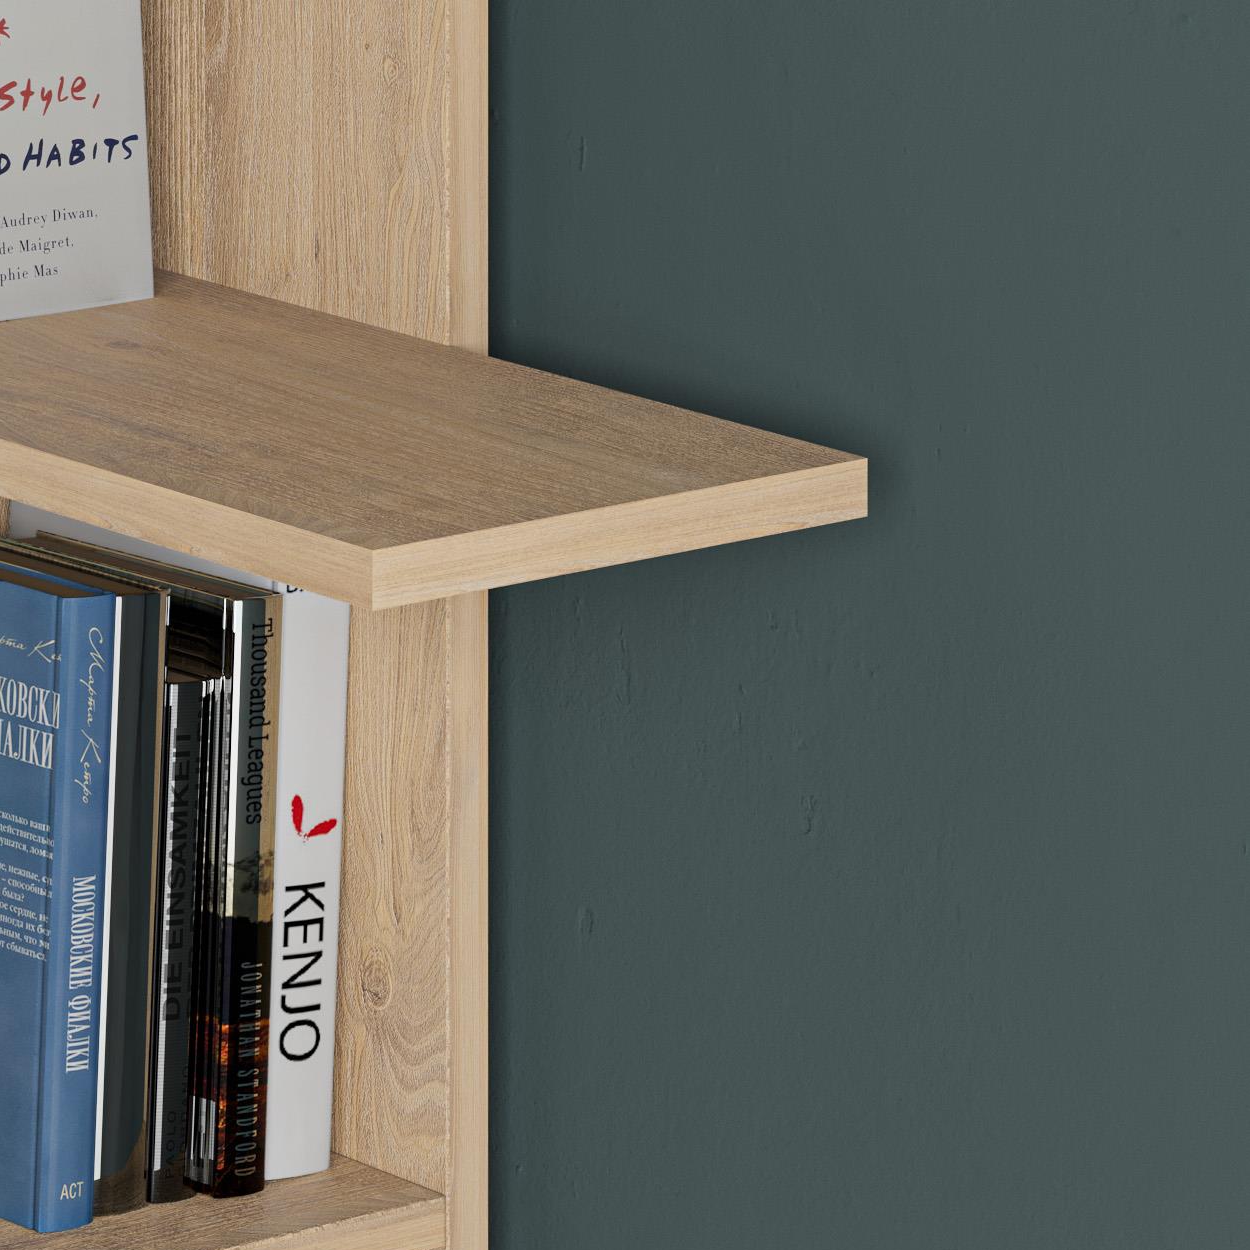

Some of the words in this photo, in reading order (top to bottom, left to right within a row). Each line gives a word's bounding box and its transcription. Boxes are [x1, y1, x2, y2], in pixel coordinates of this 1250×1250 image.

[23, 134, 138, 171] HABITS
[0, 213, 47, 229] Audrey
[34, 264, 59, 278] Mas
[79, 627, 105, 728] Марта
[248, 617, 274, 729] Thousand
[241, 734, 270, 825] Leagues
[68, 875, 97, 990] МОСКОВСКИЕ
[279, 881, 326, 1062] KENJO
[65, 994, 92, 1074] ФИАЛКИ
[238, 961, 263, 1058] JONATHAN
[234, 1068, 260, 1177] STANDFORD
